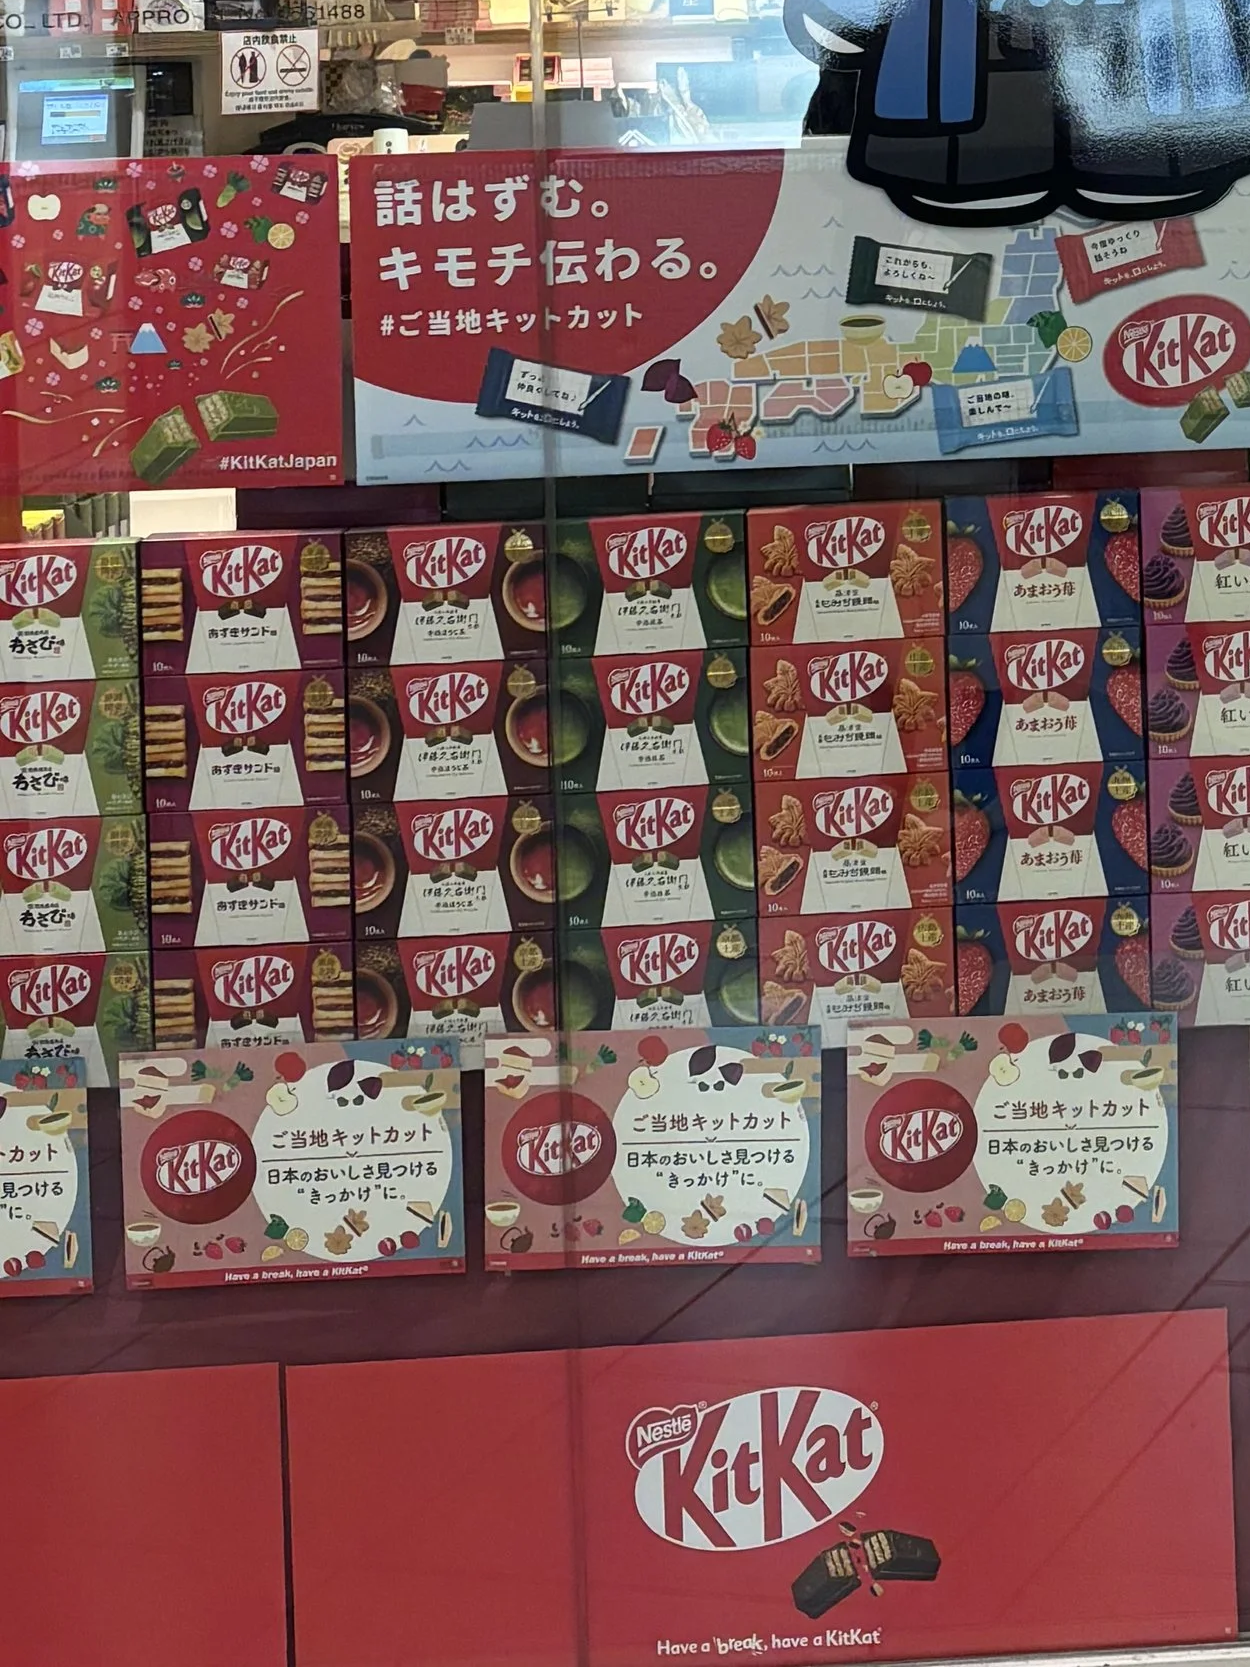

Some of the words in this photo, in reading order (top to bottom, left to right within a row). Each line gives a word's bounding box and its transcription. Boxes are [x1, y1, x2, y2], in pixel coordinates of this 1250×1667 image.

[376, 175, 611, 226] 話はずむ。
[379, 237, 717, 290] キモチ伝わる。
[381, 303, 643, 336] #ご当地キットカット
[1134, 315, 1234, 387] KitKat
[218, 452, 338, 473] #KitKatJapan
[616, 529, 685, 578] KitKat
[816, 518, 882, 566] KitKat
[1014, 507, 1080, 556] KitKat
[6, 556, 76, 607] KitKat
[212, 547, 282, 596] KitKat
[415, 538, 483, 587] KitKat
[1014, 581, 1076, 599] あまおう苺
[618, 664, 688, 713] KitKat
[819, 652, 885, 701] KitKat
[1016, 641, 1082, 689] KitKat
[9, 693, 80, 743] KitKat
[214, 683, 284, 733] KitKat
[418, 673, 487, 722] KitKat
[1015, 716, 1077, 733] あまおう苺
[623, 798, 692, 849] KitKat
[824, 786, 890, 836] KitKat
[1022, 775, 1087, 824] KitKat
[16, 829, 85, 879] KitKat
[220, 819, 290, 869] KitKat
[423, 809, 491, 859] KitKat
[1020, 849, 1083, 866] あまおう苺
[627, 934, 697, 984] KitKat
[827, 922, 894, 971] KitKat
[1025, 911, 1090, 960] KitKat
[20, 965, 89, 1015] KitKat
[223, 956, 293, 1006] KitKat
[425, 946, 493, 996] KitKat
[1023, 986, 1086, 1003] あまおう苺
[632, 1110, 793, 1133] ご当地キットカット
[993, 1097, 1152, 1120] ご当地キットカット
[272, 1127, 433, 1151] ご当地キットカット
[529, 1125, 600, 1173] KitKat
[627, 1147, 796, 1169] 日本のおいしさ見つける
[886, 1111, 960, 1161] KitKat
[987, 1135, 1155, 1157] 日本のおいしさ見つける
[165, 1143, 239, 1191] KitKat
[267, 1160, 438, 1185] 日本のおいしさ見つける
[656, 1169, 766, 1190] “きっかけ”に。
[1016, 1156, 1124, 1177] “きっかけ”に。
[297, 1184, 407, 1205] “きっかけ”に。
[581, 1255, 607, 1265] Have
[652, 1252, 676, 1261] have
[944, 1242, 968, 1251] Have
[970, 1242, 977, 1250] a
[1013, 1240, 1037, 1249] have
[1039, 1241, 1045, 1249] a
[224, 1272, 250, 1281] Have
[296, 1269, 320, 1277] have
[636, 1412, 694, 1444] Nestlé
[662, 1389, 875, 1547] KitKat
[657, 1638, 699, 1656] Have
[702, 1643, 711, 1654] a
[771, 1635, 808, 1651] have
[813, 1639, 823, 1649] a
[826, 1628, 881, 1646] KitKat
